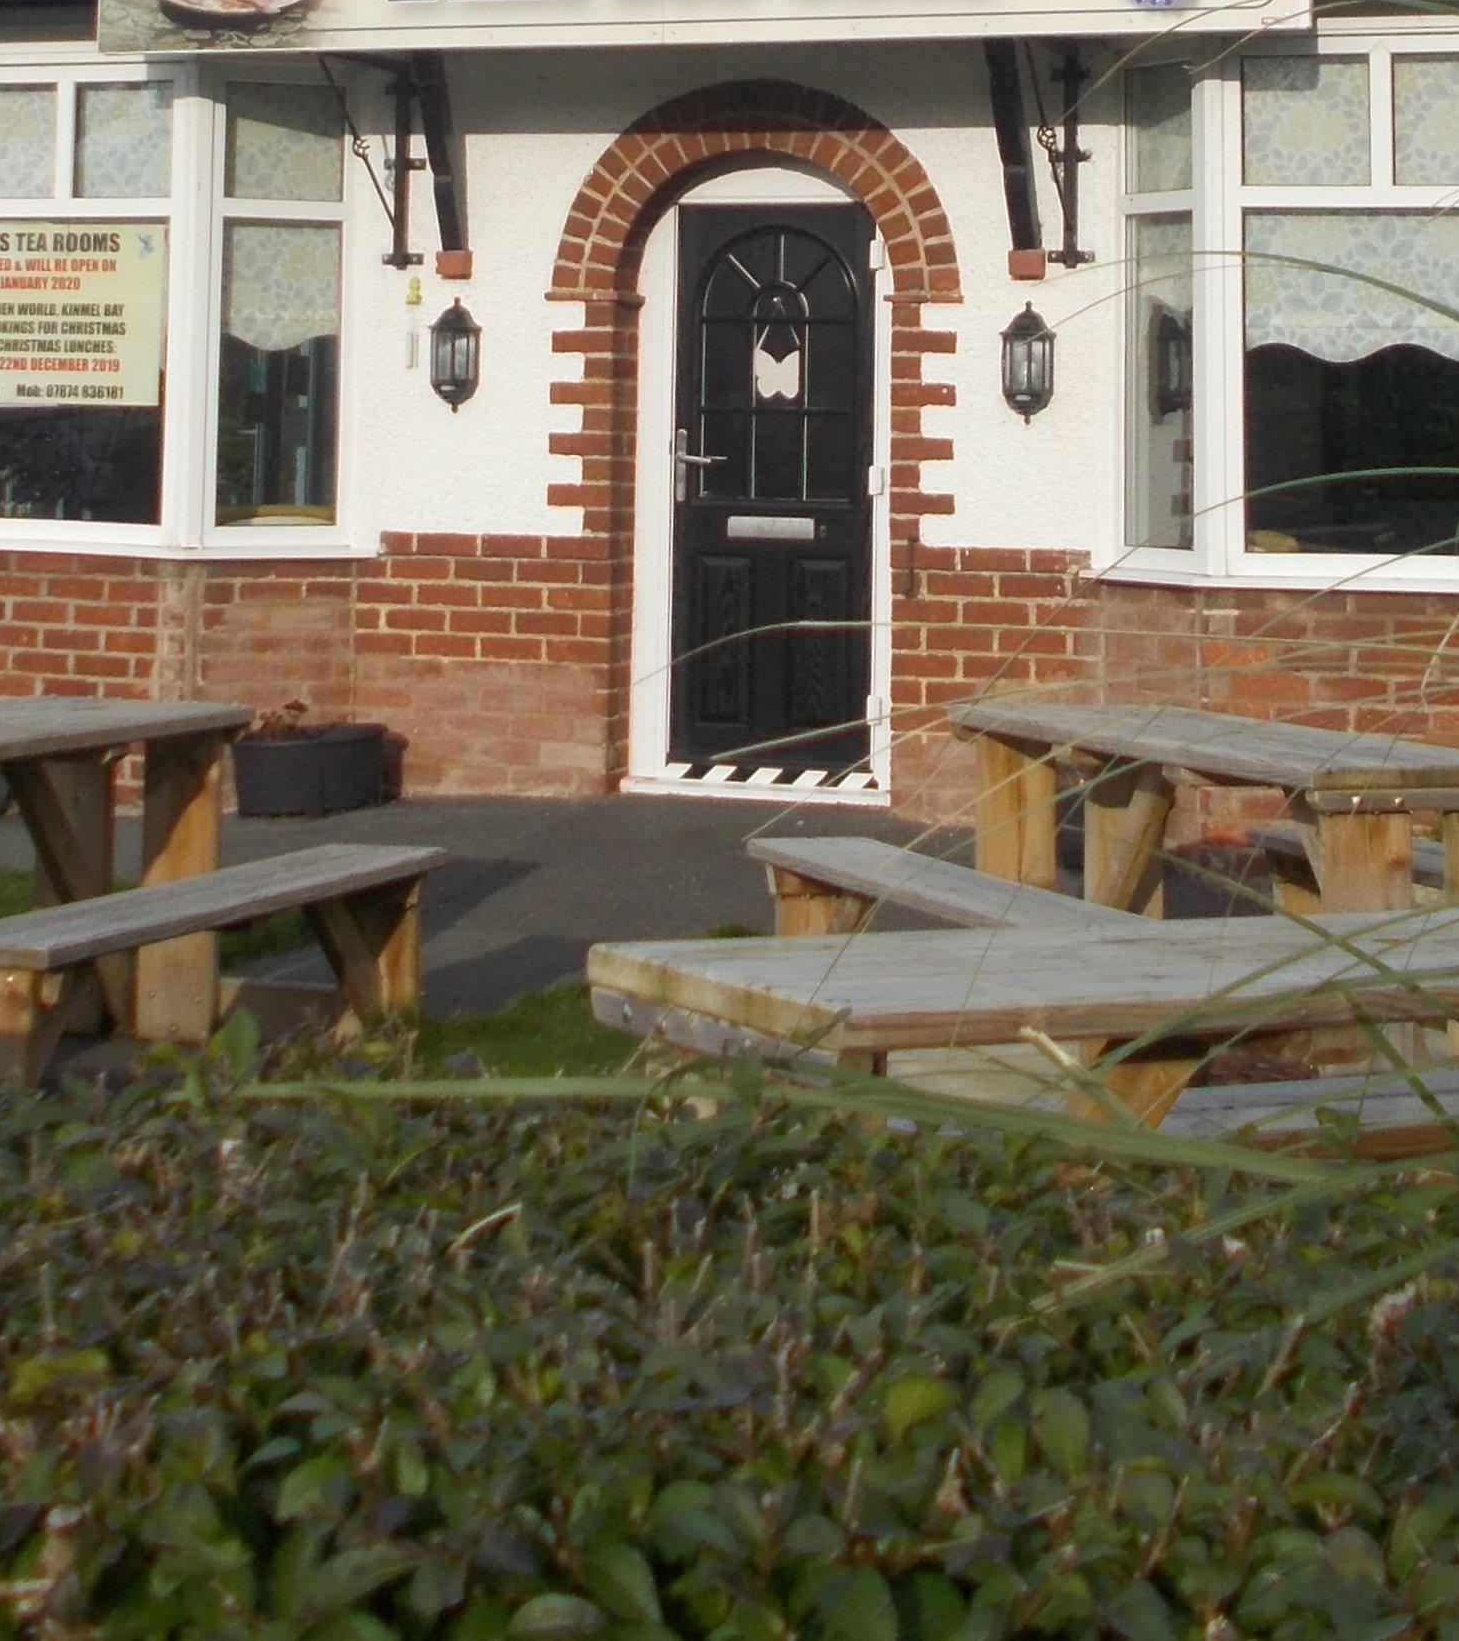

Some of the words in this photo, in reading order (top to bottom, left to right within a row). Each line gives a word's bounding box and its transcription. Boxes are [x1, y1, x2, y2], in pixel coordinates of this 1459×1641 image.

[16, 232, 47, 252] TEA
[52, 232, 121, 253] ROOMS
[15, 260, 22, 271] &
[25, 258, 51, 271] WILL
[54, 259, 68, 272] BE
[71, 259, 99, 272] OPEN
[102, 259, 117, 272] ON
[0, 276, 48, 290] JANUARY
[52, 277, 81, 290] 2020
[61, 303, 102, 317] KINMEL
[104, 303, 125, 317] BAY
[37, 321, 58, 334] FOR
[61, 321, 127, 336] CHRISTMAS
[0, 357, 27, 370] 22ND
[30, 357, 89, 371] DECEMBER
[92, 358, 120, 372] 2019
[16, 384, 44, 397] Mob:
